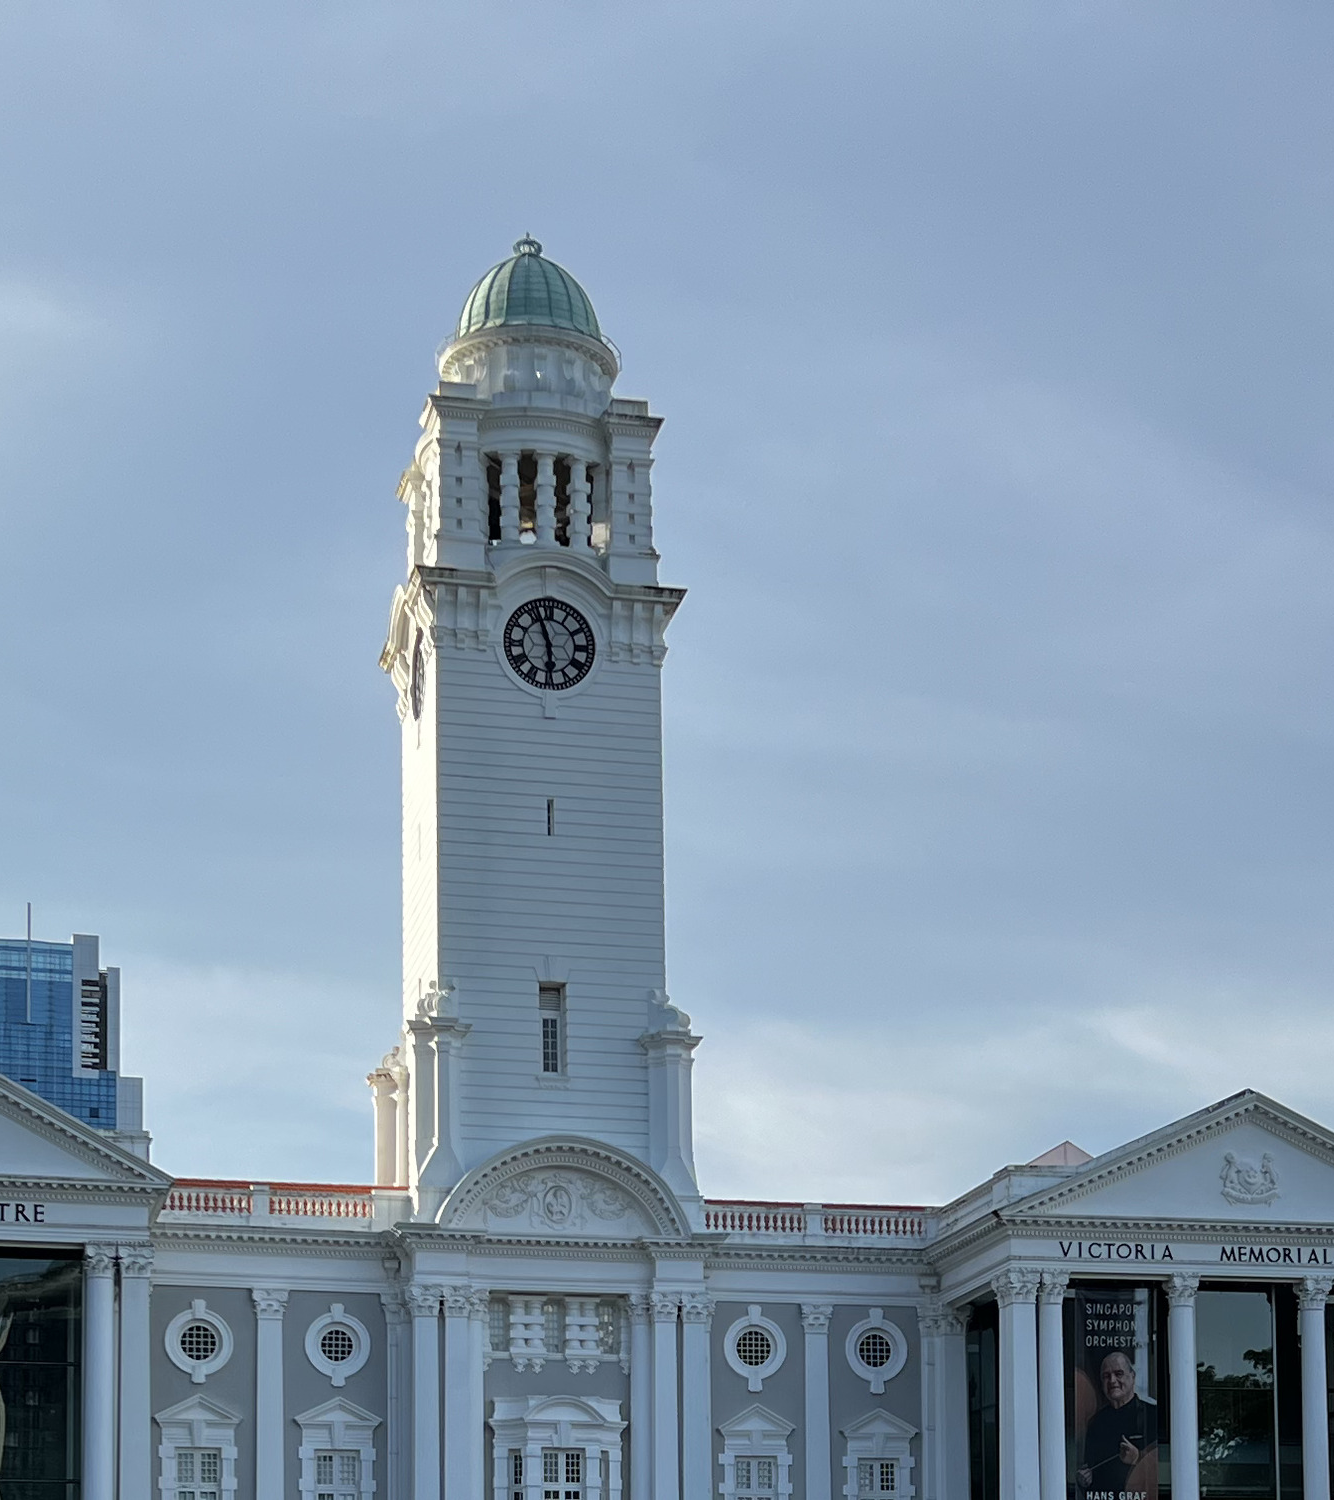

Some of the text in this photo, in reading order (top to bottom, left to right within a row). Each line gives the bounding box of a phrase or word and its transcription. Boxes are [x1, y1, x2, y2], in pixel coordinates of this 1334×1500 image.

[1059, 1241, 1174, 1261] VICTORIA
[1219, 1246, 1333, 1265] MEMORIAL
[1086, 1491, 1147, 1500] HANS GRAF
